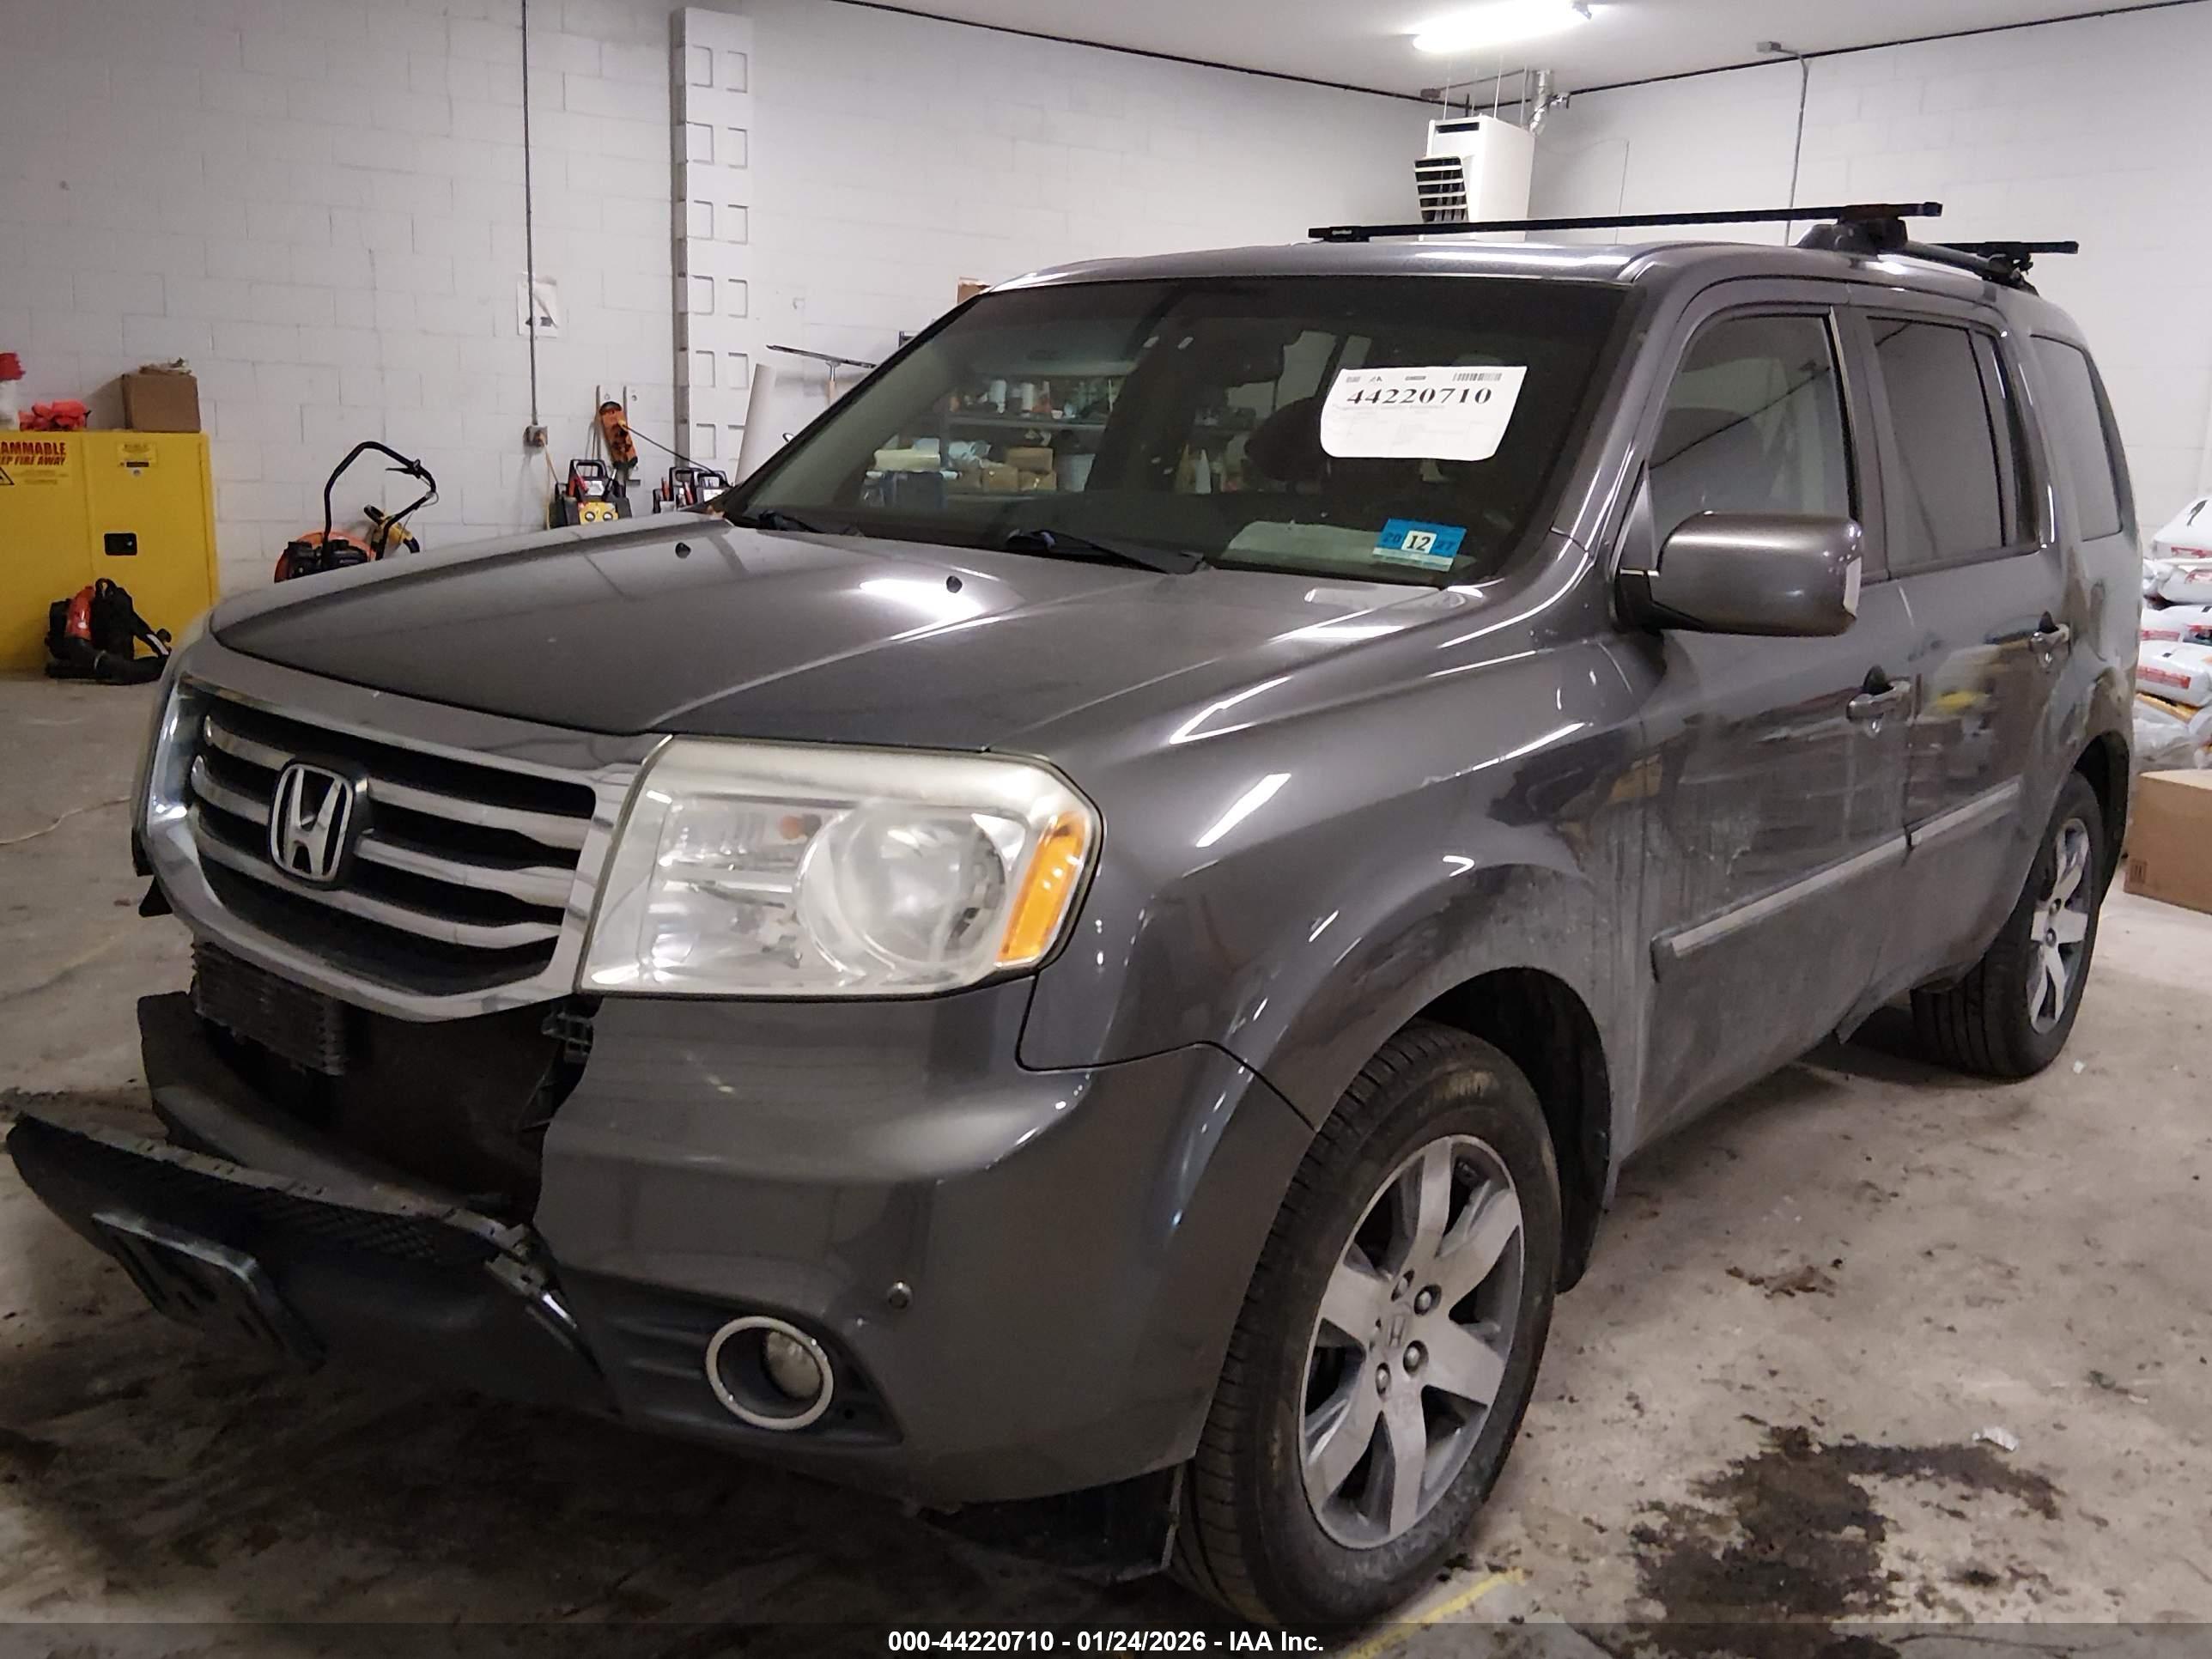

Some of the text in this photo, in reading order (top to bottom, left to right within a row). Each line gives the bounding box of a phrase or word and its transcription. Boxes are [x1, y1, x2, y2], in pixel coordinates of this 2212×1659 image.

[1346, 387, 1492, 404] 44220710
[15, 456, 35, 465] FIRE
[37, 456, 66, 465] AWAY
[1407, 534, 1431, 551] 12
